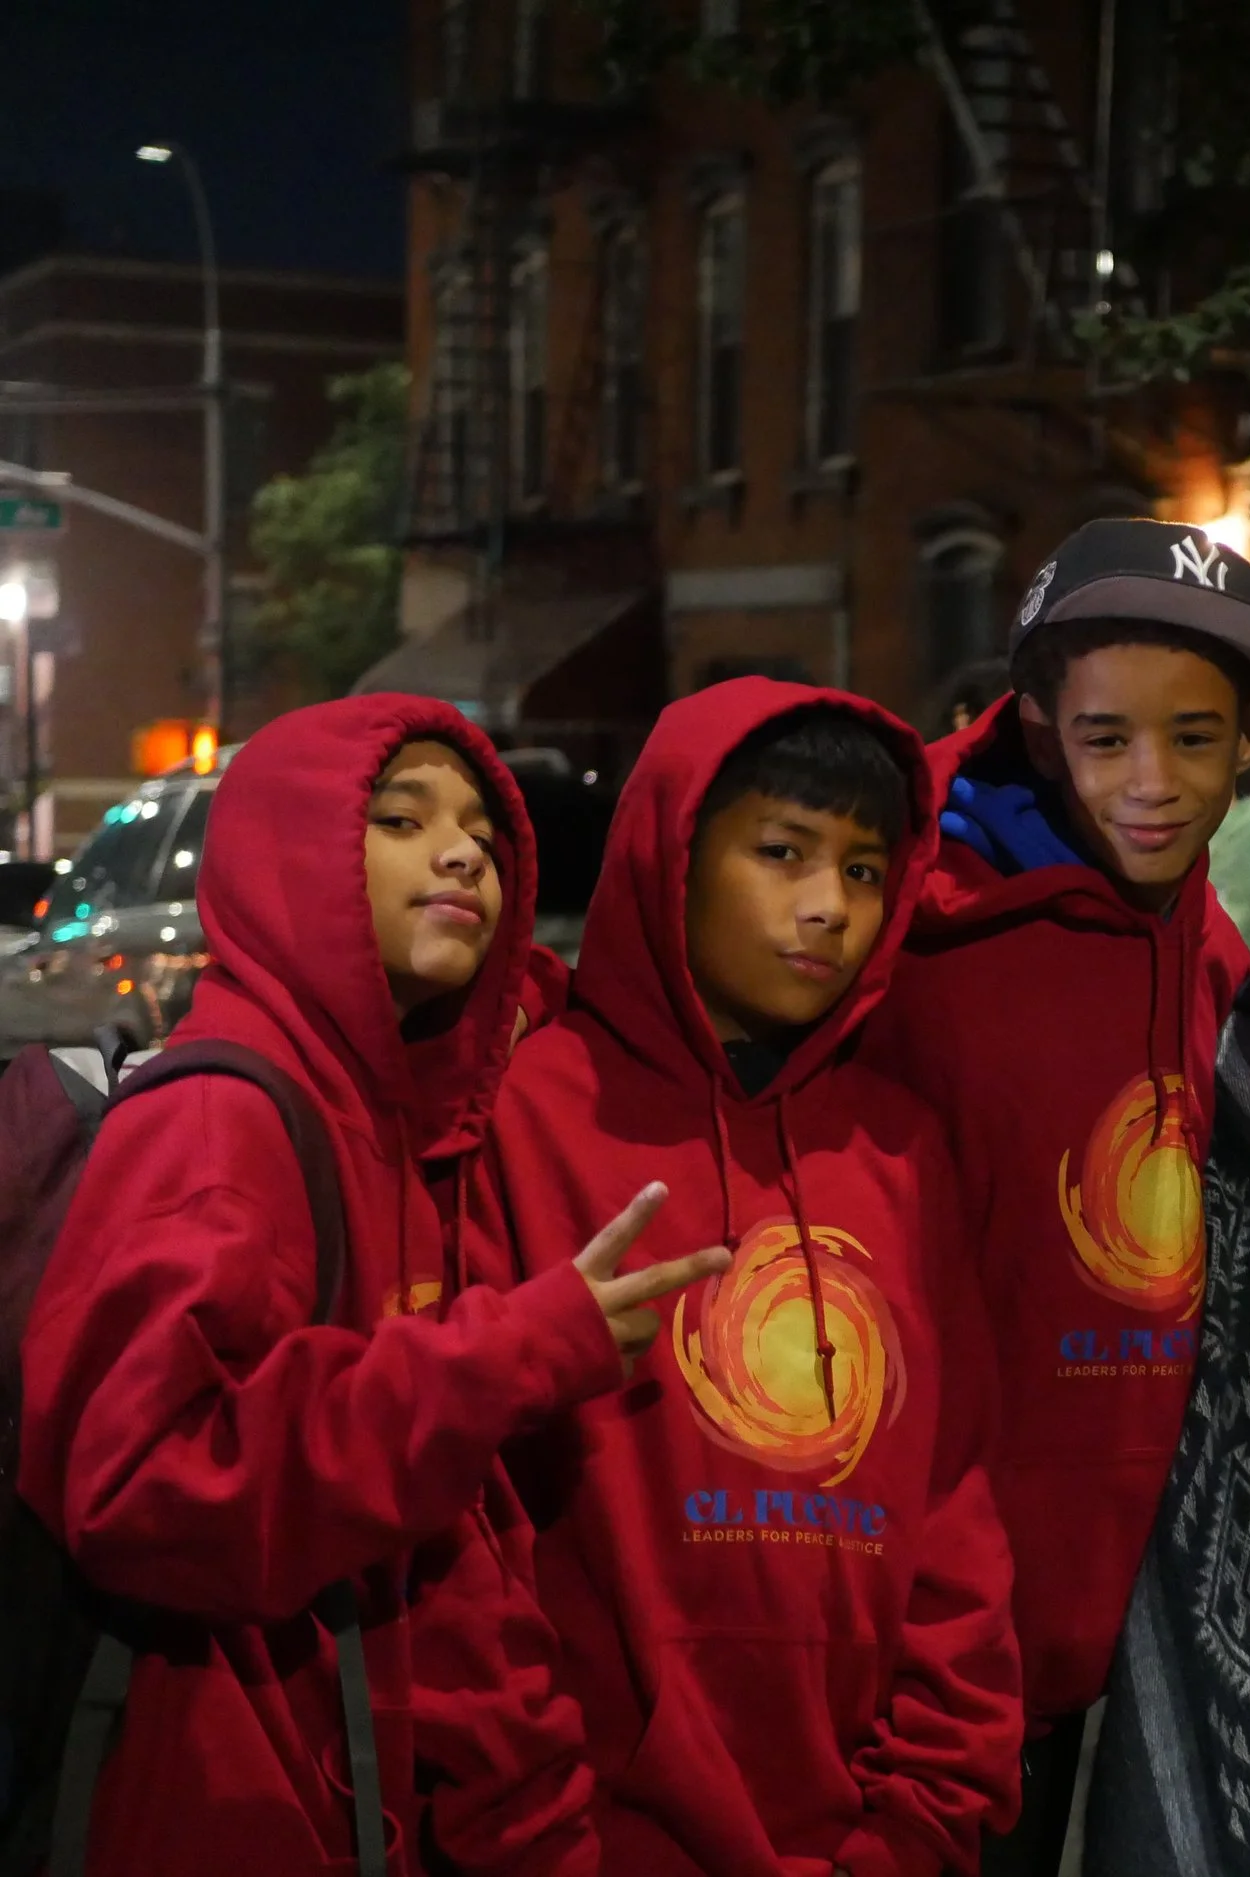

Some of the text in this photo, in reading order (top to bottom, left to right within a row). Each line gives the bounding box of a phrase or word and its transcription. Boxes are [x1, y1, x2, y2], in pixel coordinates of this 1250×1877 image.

[1169, 535, 1229, 591] NY
[1057, 1365, 1117, 1377] LEADERS
[1122, 1364, 1147, 1376] FOR
[683, 1530, 754, 1543] LEADERS
[761, 1530, 790, 1543] FOR
[796, 1531, 835, 1546] PEACE
